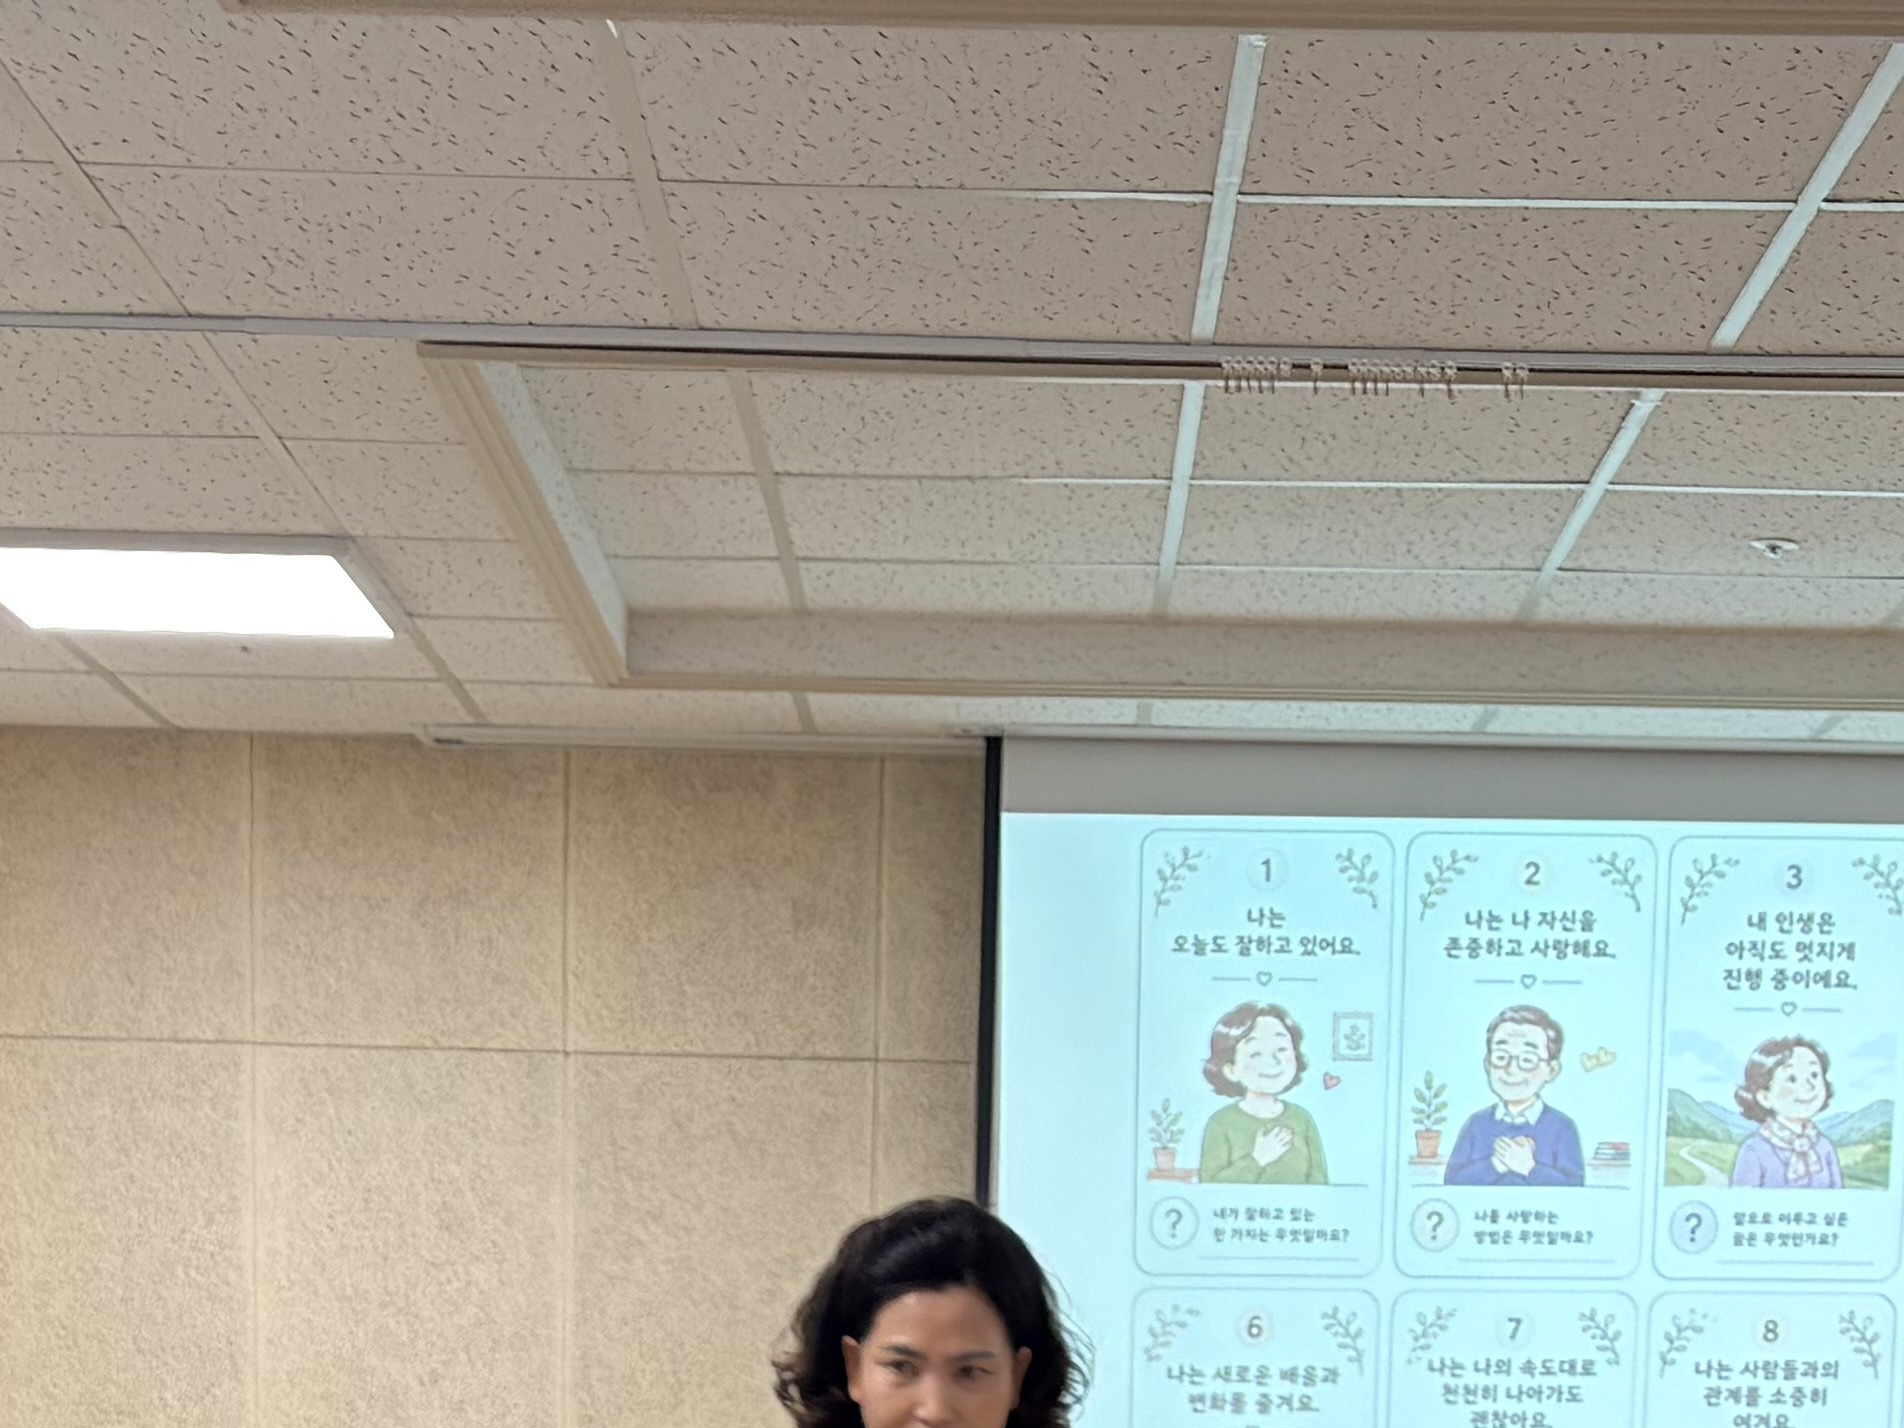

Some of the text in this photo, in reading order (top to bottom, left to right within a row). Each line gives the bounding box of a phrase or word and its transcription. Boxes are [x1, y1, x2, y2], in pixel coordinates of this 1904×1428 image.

[1260, 858, 1271, 882] 1
[1524, 861, 1541, 886] 2
[1786, 864, 1803, 890] 3
[1247, 906, 1286, 929] 나는
[1465, 909, 1596, 933] 나는 나 자신을
[1747, 912, 1836, 935] 내 인생은
[1171, 934, 1229, 957] 오늘도
[1235, 935, 1293, 957] 잘하고
[1444, 936, 1524, 959] 존중하고
[1725, 940, 1856, 963] 아직도 멋지게
[1723, 968, 1763, 991] 진행
[1165, 1208, 1183, 1238] ?
[1426, 1210, 1444, 1241] ?
[1685, 1212, 1702, 1243] ?
[1507, 1317, 1522, 1341] 7
[1763, 1319, 1779, 1342] 8
[1428, 1357, 1597, 1379] 나는 나의 속도대로
[1695, 1359, 1839, 1381] 나는 사람들과의
[1442, 1383, 1584, 1405] 천천히 나아가도
[1703, 1386, 1828, 1408] 관계를 소중히
